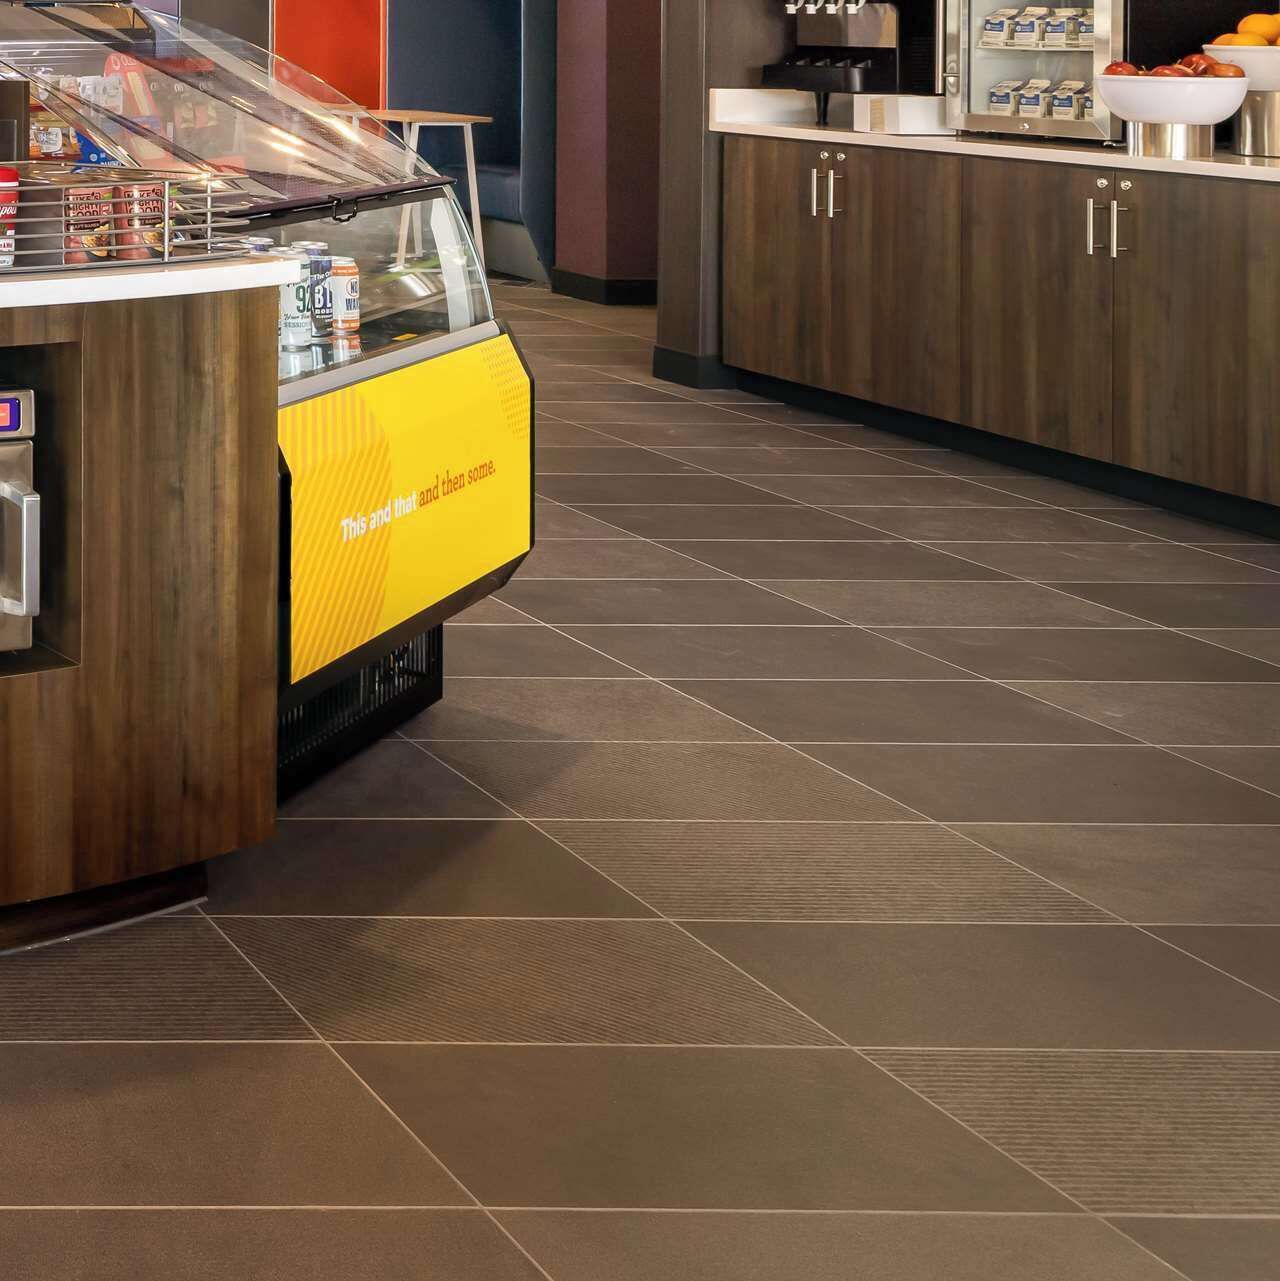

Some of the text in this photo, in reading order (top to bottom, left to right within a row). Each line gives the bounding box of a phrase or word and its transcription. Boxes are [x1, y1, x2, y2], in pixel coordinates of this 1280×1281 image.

[341, 459, 496, 543] This and that and then some.
